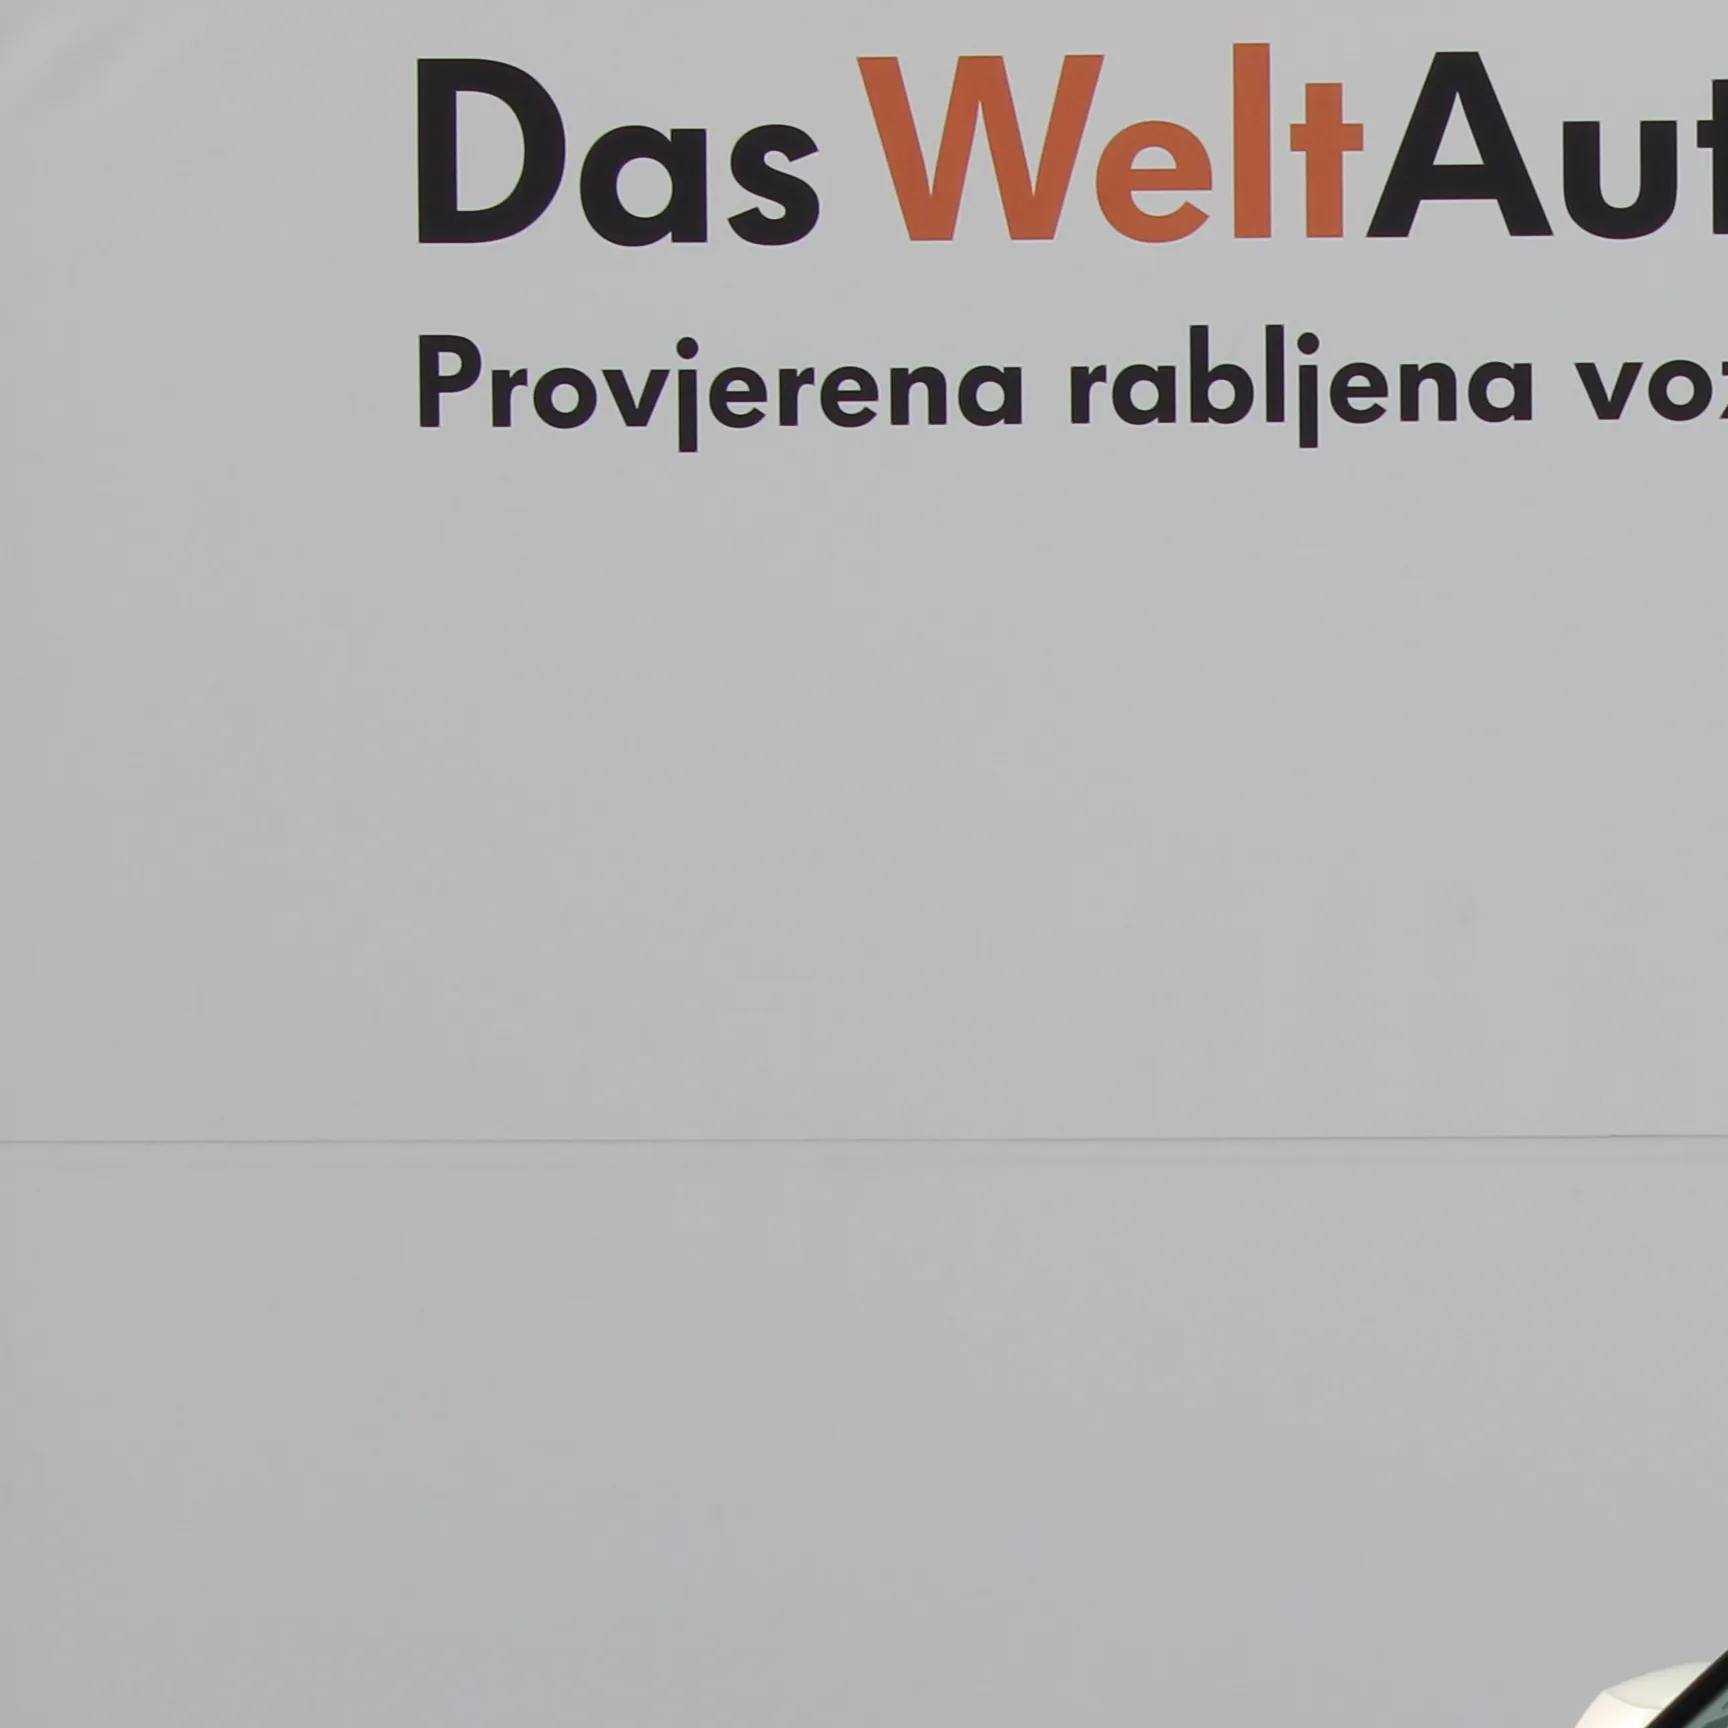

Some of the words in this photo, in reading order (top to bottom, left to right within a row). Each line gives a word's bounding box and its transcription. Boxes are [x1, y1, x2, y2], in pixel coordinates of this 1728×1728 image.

[417, 58, 820, 247] Das
[418, 334, 1023, 453] Provjerena
[1070, 324, 1533, 449] rabljena
